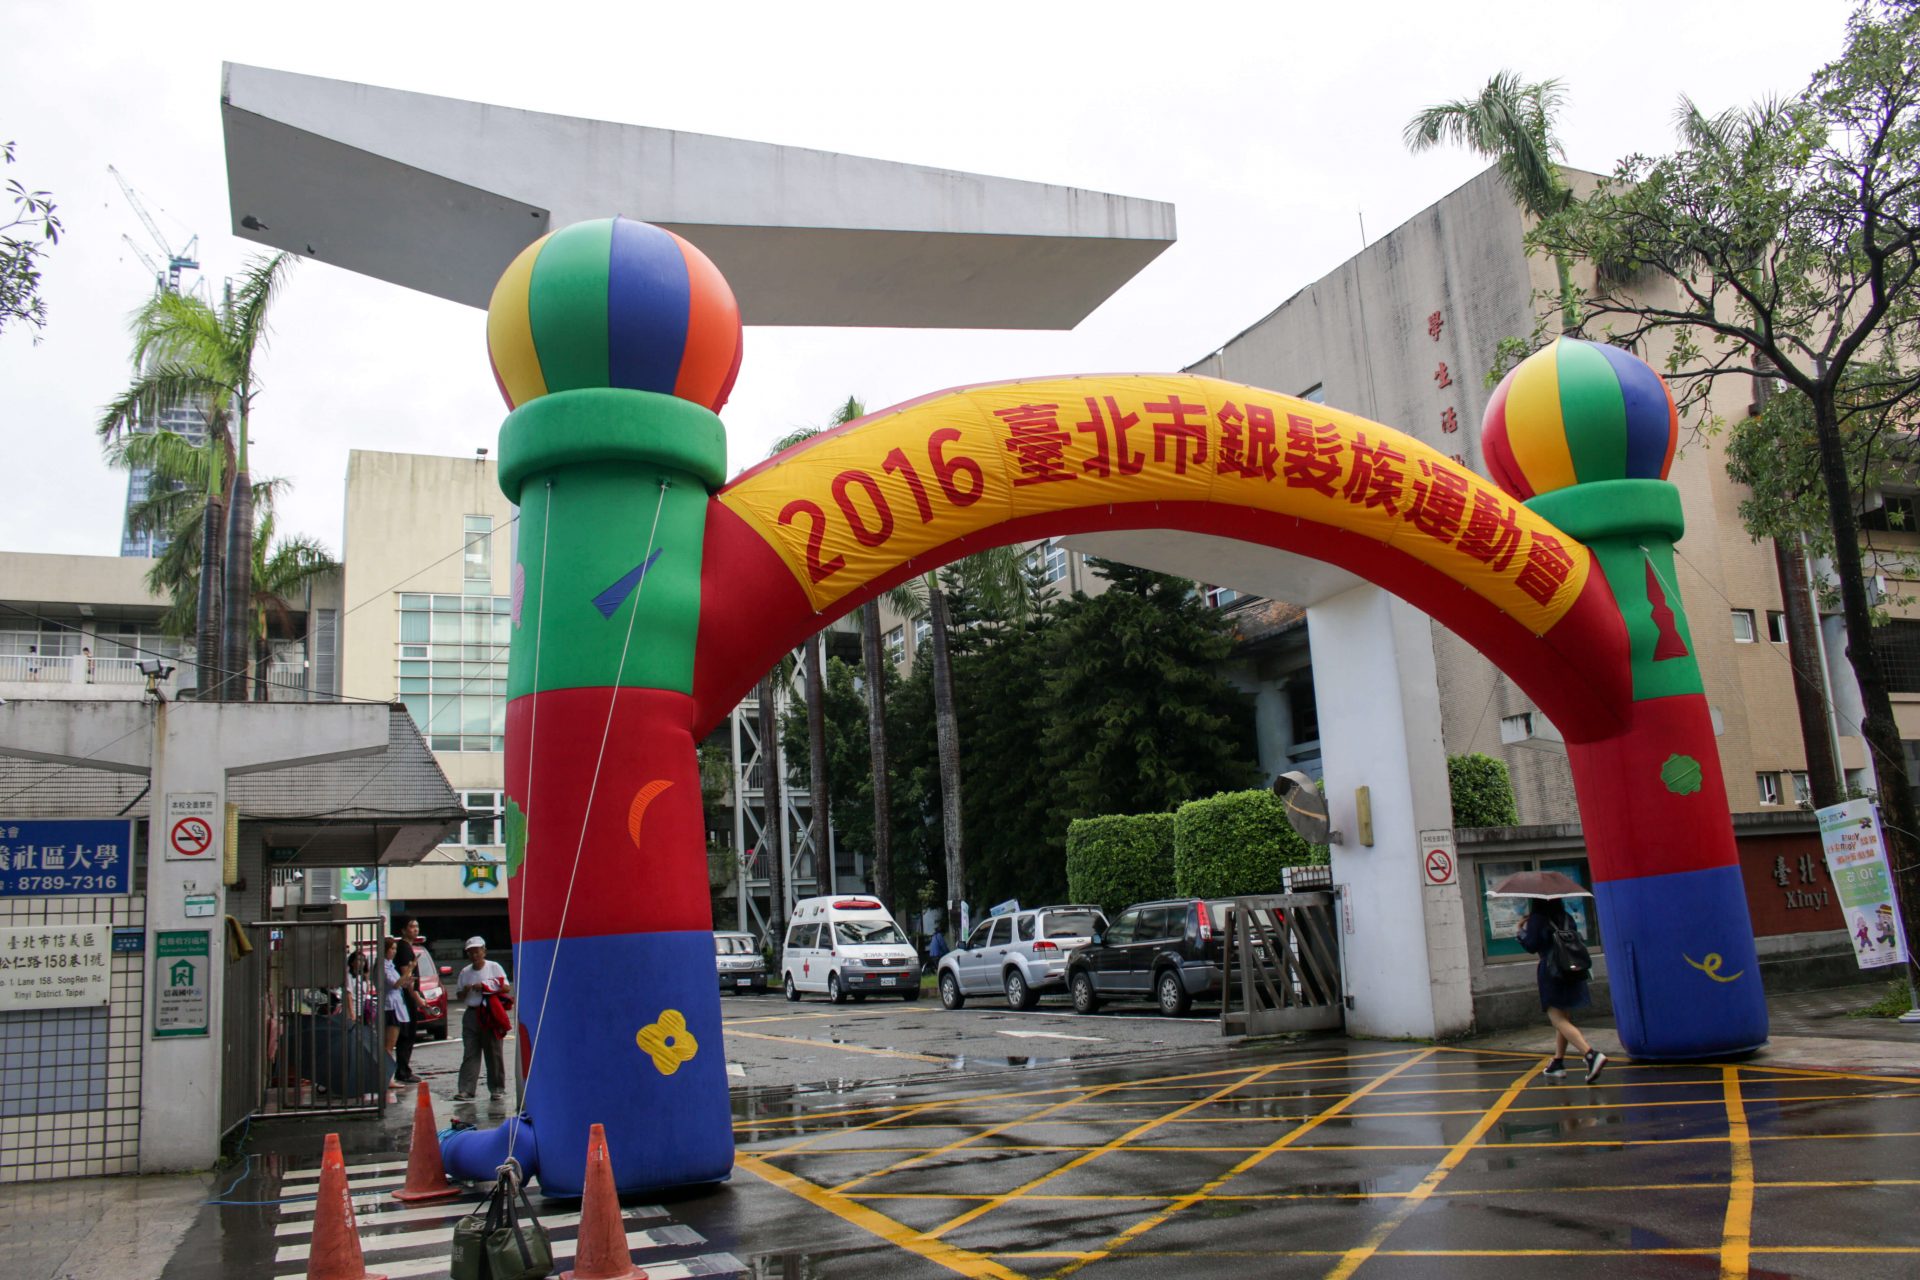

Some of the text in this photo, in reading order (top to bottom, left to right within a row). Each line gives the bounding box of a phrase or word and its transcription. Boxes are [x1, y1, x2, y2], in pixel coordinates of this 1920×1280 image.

[1427, 310, 1465, 467] 學生活
[777, 395, 1574, 607] 2016 臺北市銀髮族運動會
[18, 875, 117, 890] 8789-7316
[1786, 888, 1829, 910] Xinyi
[8, 933, 95, 950] 臺北市信義區
[18, 978, 35, 986] Lane
[58, 975, 88, 985] SongRen
[15, 991, 31, 1000] Xinyi
[66, 988, 85, 997] Taipei
